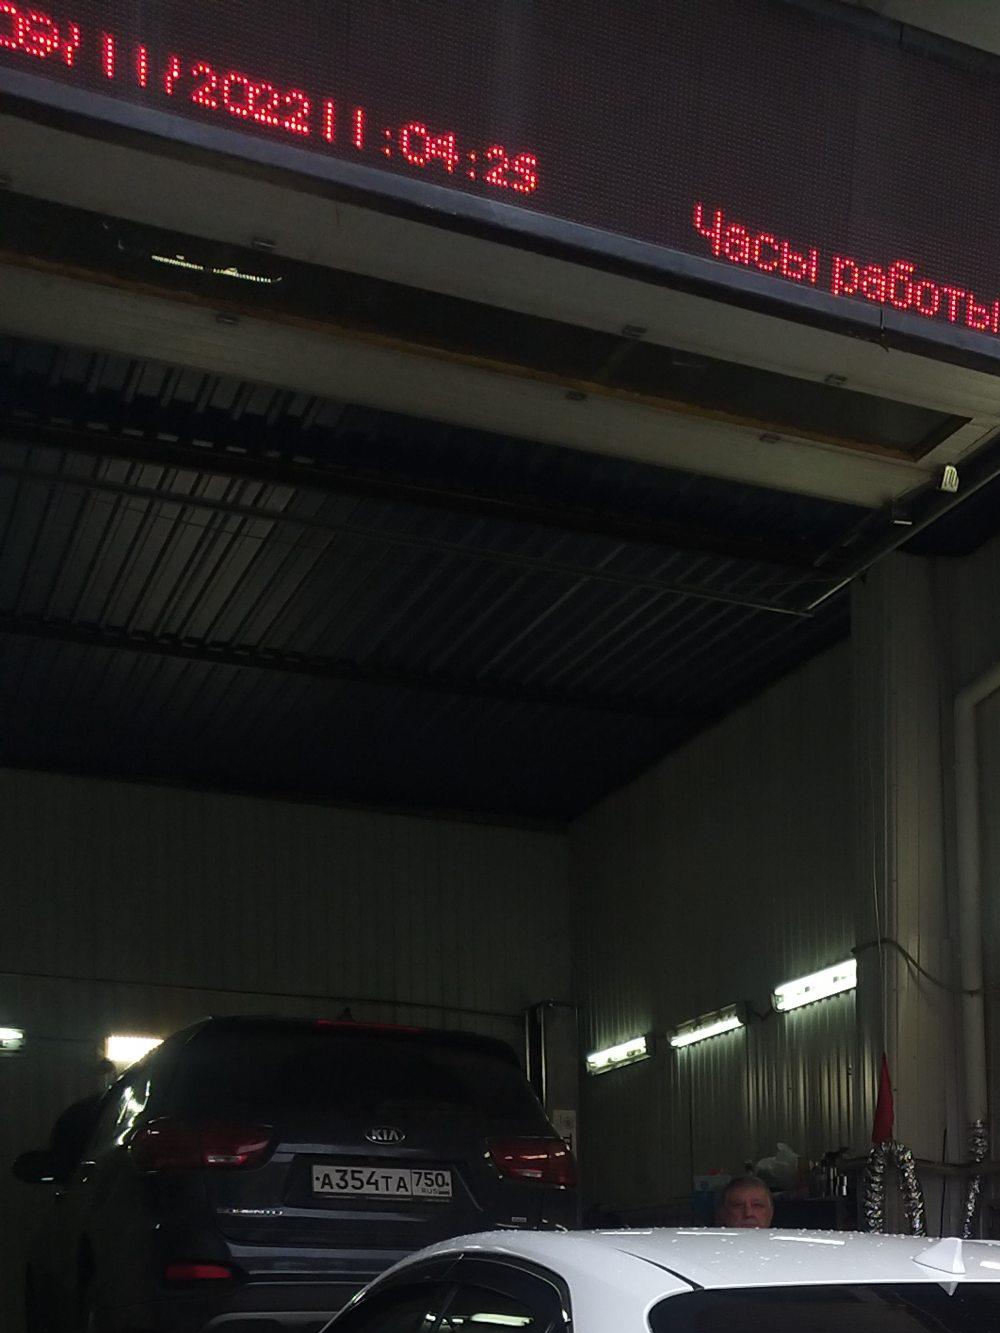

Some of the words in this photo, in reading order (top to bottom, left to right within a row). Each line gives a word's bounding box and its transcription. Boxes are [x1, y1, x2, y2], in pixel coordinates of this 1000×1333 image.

[693, 204, 820, 283] Часы
[830, 256, 1000, 334] работы
[371, 1128, 399, 1141] KIA
[320, 1169, 409, 1192] А354ТА
[413, 1171, 446, 1188] 750
